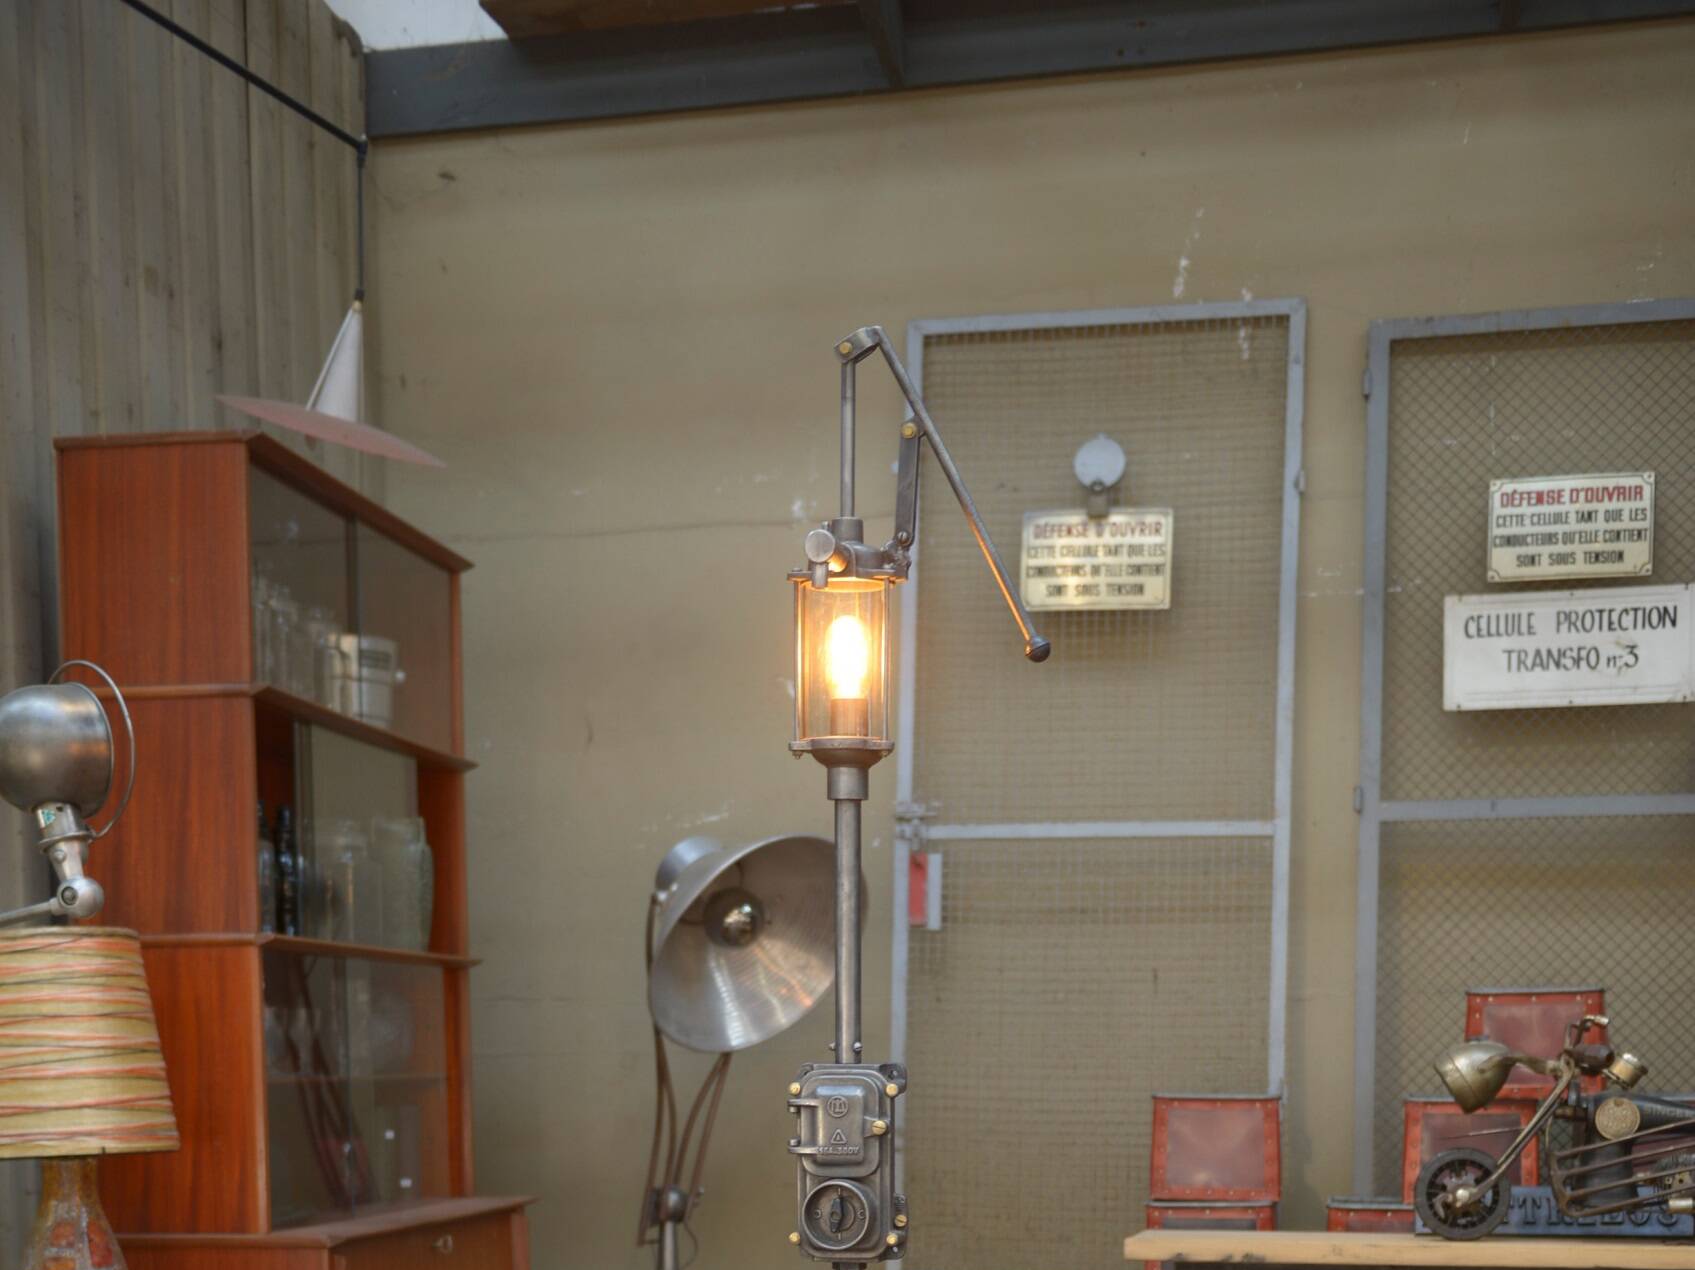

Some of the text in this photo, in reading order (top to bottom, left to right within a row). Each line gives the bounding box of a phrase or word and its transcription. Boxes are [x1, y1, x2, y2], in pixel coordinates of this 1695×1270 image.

[1500, 485, 1644, 508] DÉFENSE D'OUVRIR
[1496, 507, 1648, 528] CETTE CELLULE TANT QUE LES
[1493, 528, 1648, 548] CONDUCTEURS QU'ELLE CONTIENT
[1516, 550, 1624, 568] SONT SOUS TENSION
[1464, 604, 1678, 639] CELLULE PROTECTION
[1502, 646, 1600, 674] TRANSFO
